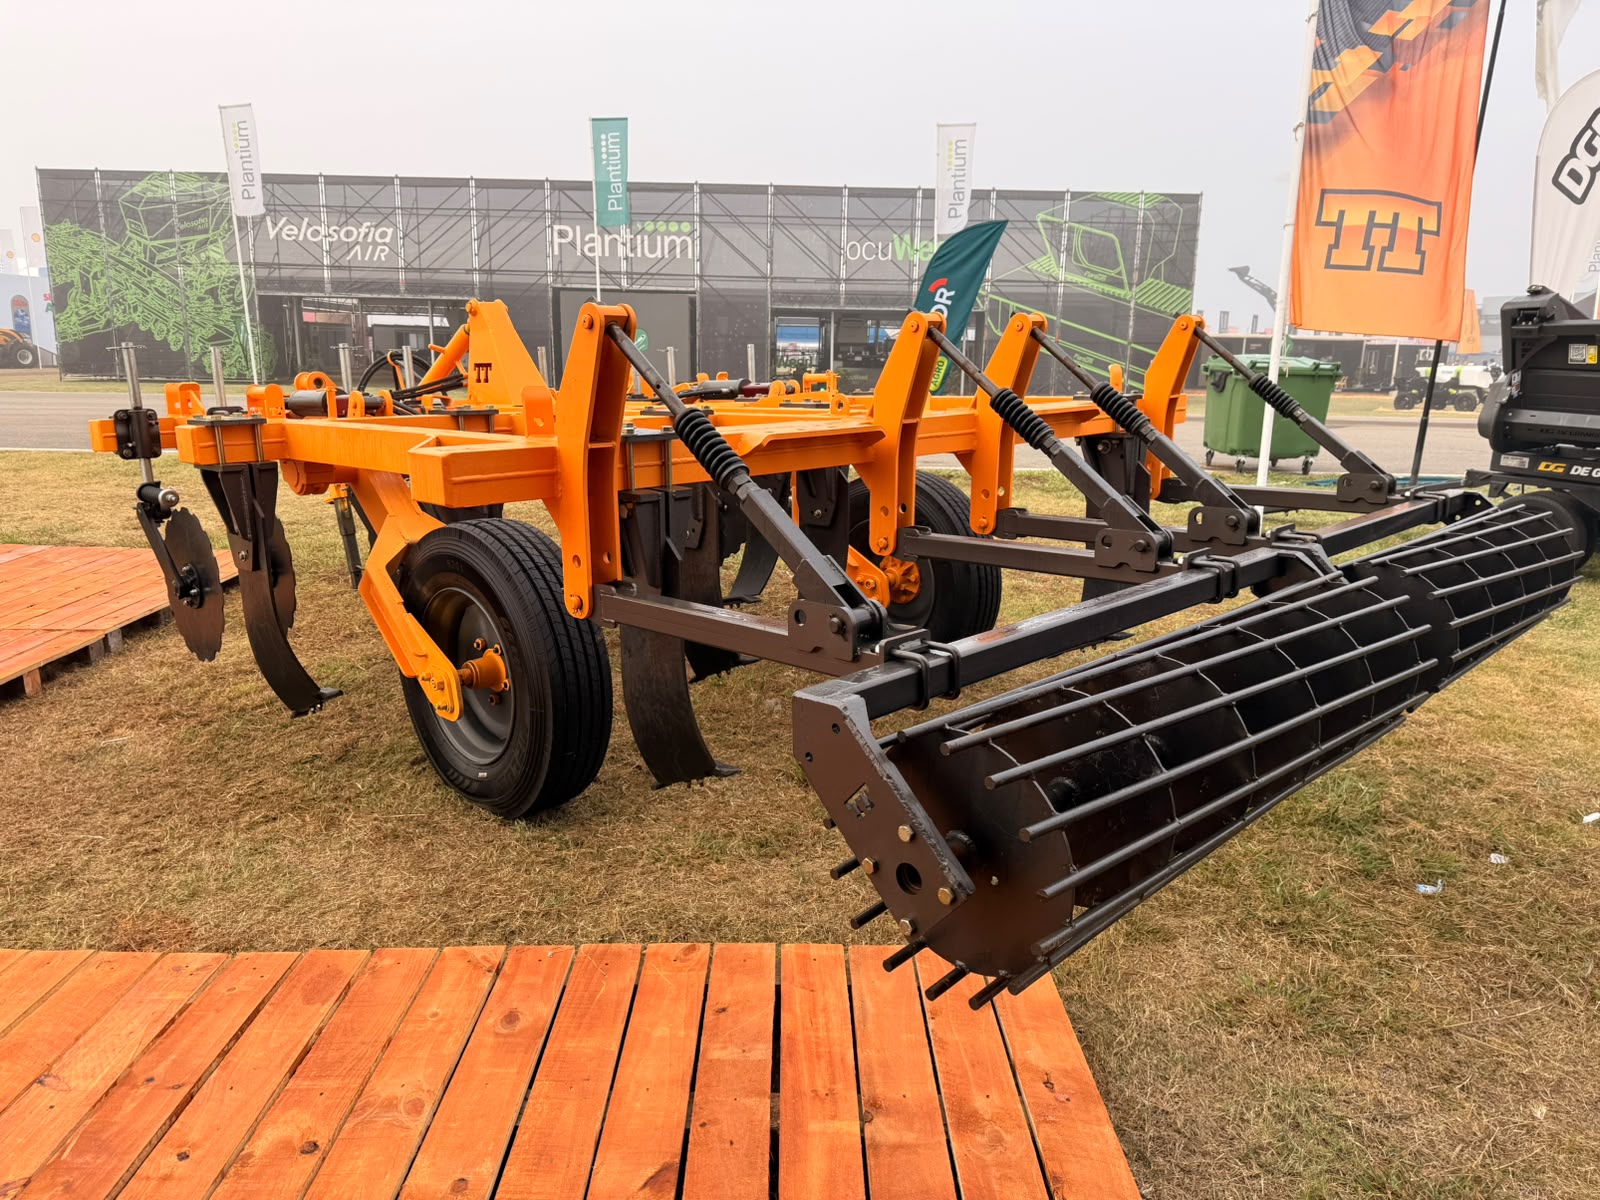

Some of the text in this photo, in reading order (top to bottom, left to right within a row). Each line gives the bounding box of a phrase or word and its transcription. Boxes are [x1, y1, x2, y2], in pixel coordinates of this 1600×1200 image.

[232, 120, 256, 200] Plantium
[601, 132, 623, 211] Plantium
[947, 138, 968, 219] Plantium
[266, 215, 394, 243] Velosofia
[552, 221, 693, 260] Plantium
[345, 245, 390, 261] AIR
[846, 233, 946, 262] ocuWe
[932, 360, 945, 387] AGRO
[1537, 461, 1567, 473] DG
[1569, 465, 1592, 476] DE
